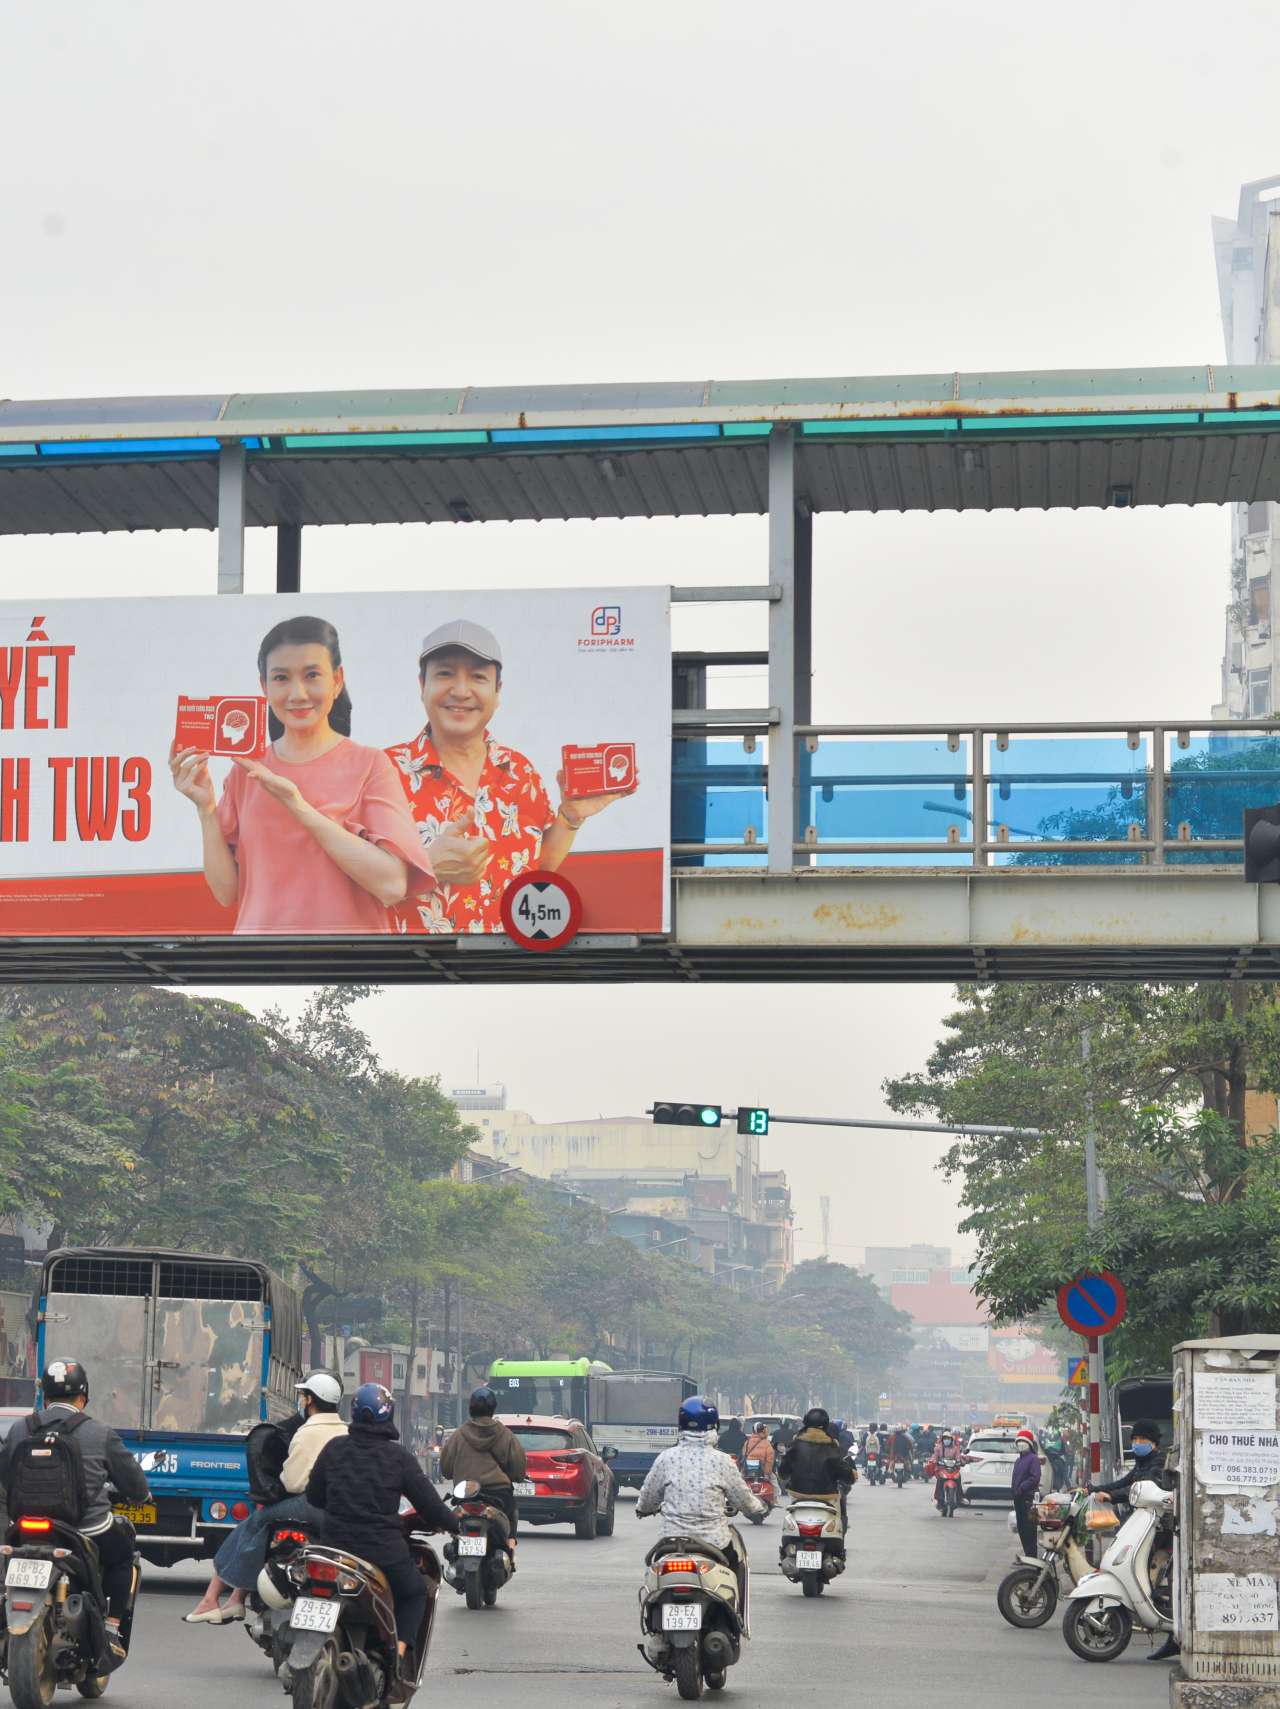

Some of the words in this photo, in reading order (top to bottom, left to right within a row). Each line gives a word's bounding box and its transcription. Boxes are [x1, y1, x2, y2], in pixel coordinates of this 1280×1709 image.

[578, 638, 634, 646] FORIPHARM
[48, 756, 152, 842] TW3
[518, 894, 561, 927] 4,5m
[750, 1110, 767, 1134] 13
[509, 1378, 520, 1388] E03
[1209, 1434, 1229, 1445] CHO
[1231, 1434, 1255, 1447] THUÊ
[1258, 1435, 1279, 1447] NHÀ
[190, 1461, 241, 1469] FRONTIER
[1211, 1464, 1225, 1472] ĐT:
[1226, 1465, 1278, 1474] 096.383.0719
[460, 1546, 484, 1555] 157.54
[800, 1552, 818, 1560] 12-B1
[16, 1562, 46, 1575] 18-B2
[8, 1573, 47, 1587] 869.12
[300, 1600, 333, 1615] 29-E2
[668, 1605, 696, 1617] 29-E2
[293, 1613, 332, 1630] 535.74
[666, 1617, 699, 1628] 139.79
